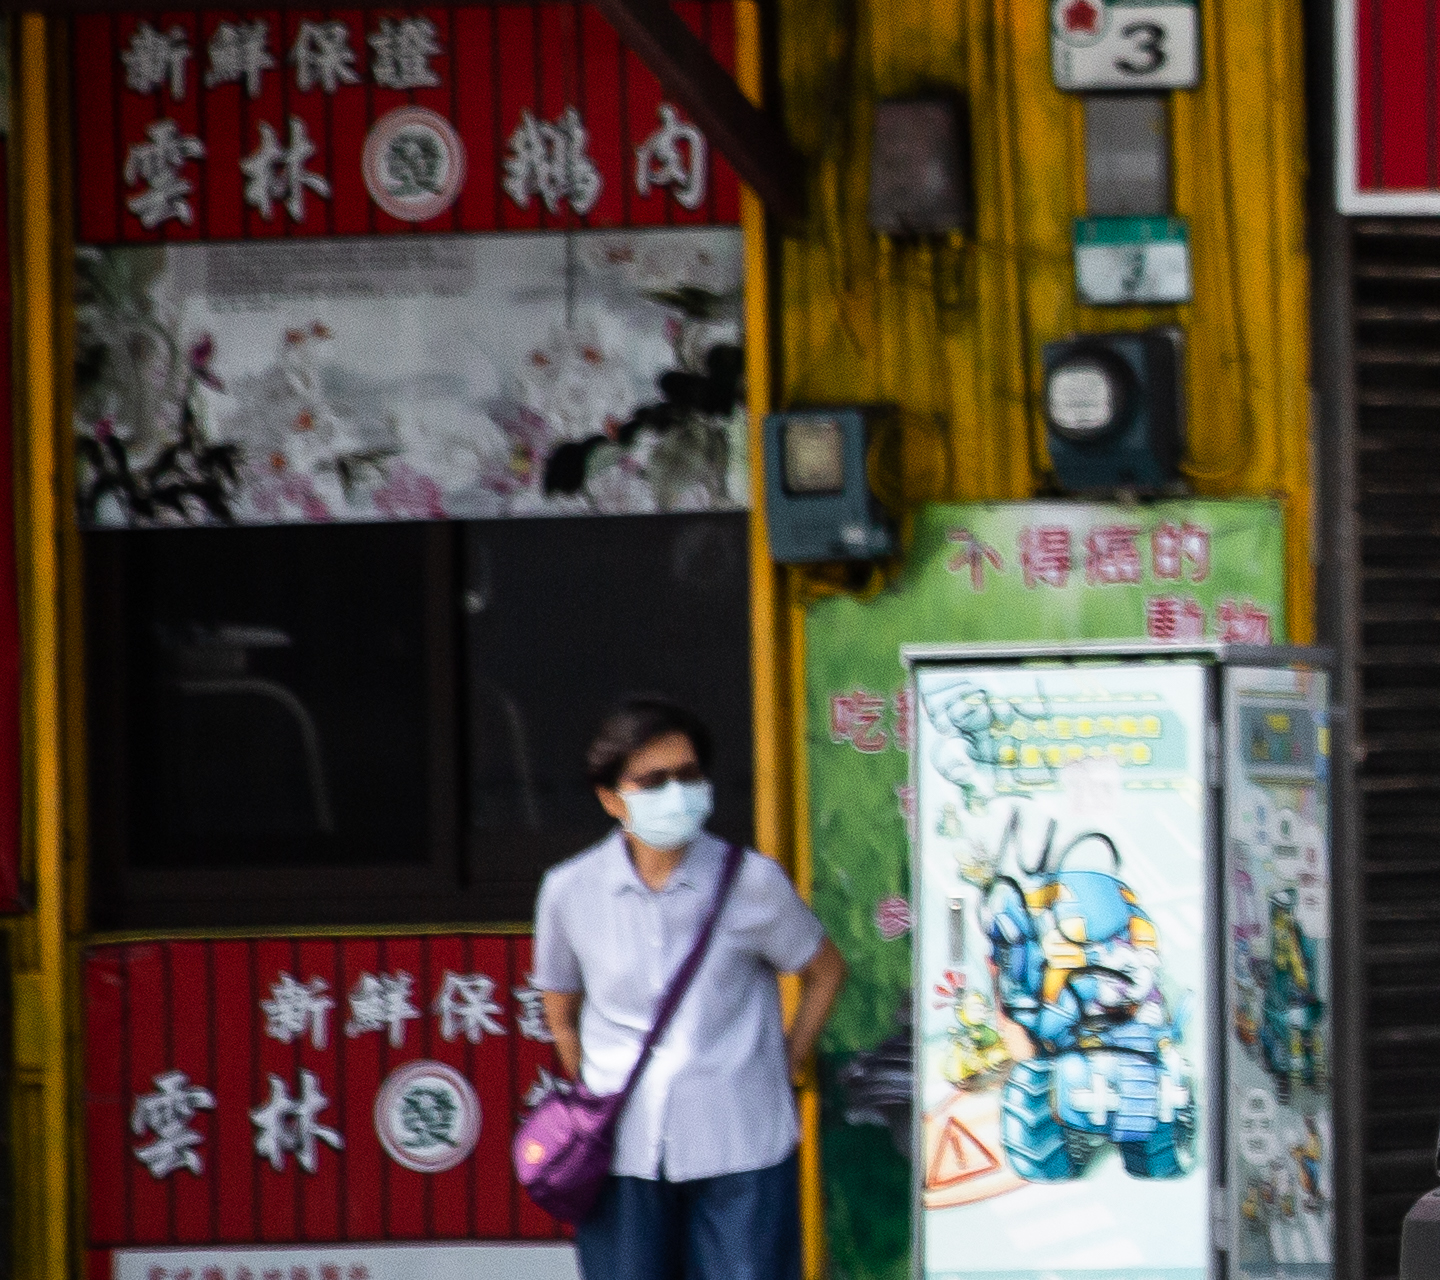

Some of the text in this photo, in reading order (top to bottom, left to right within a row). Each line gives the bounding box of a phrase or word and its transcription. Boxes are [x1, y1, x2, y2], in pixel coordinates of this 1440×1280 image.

[122, 18, 442, 99] 新鮮保證
[1115, 21, 1169, 77] 3
[124, 120, 333, 228] 雲林
[946, 520, 1212, 591] 不得癌的
[131, 1068, 344, 1179] 雲林
